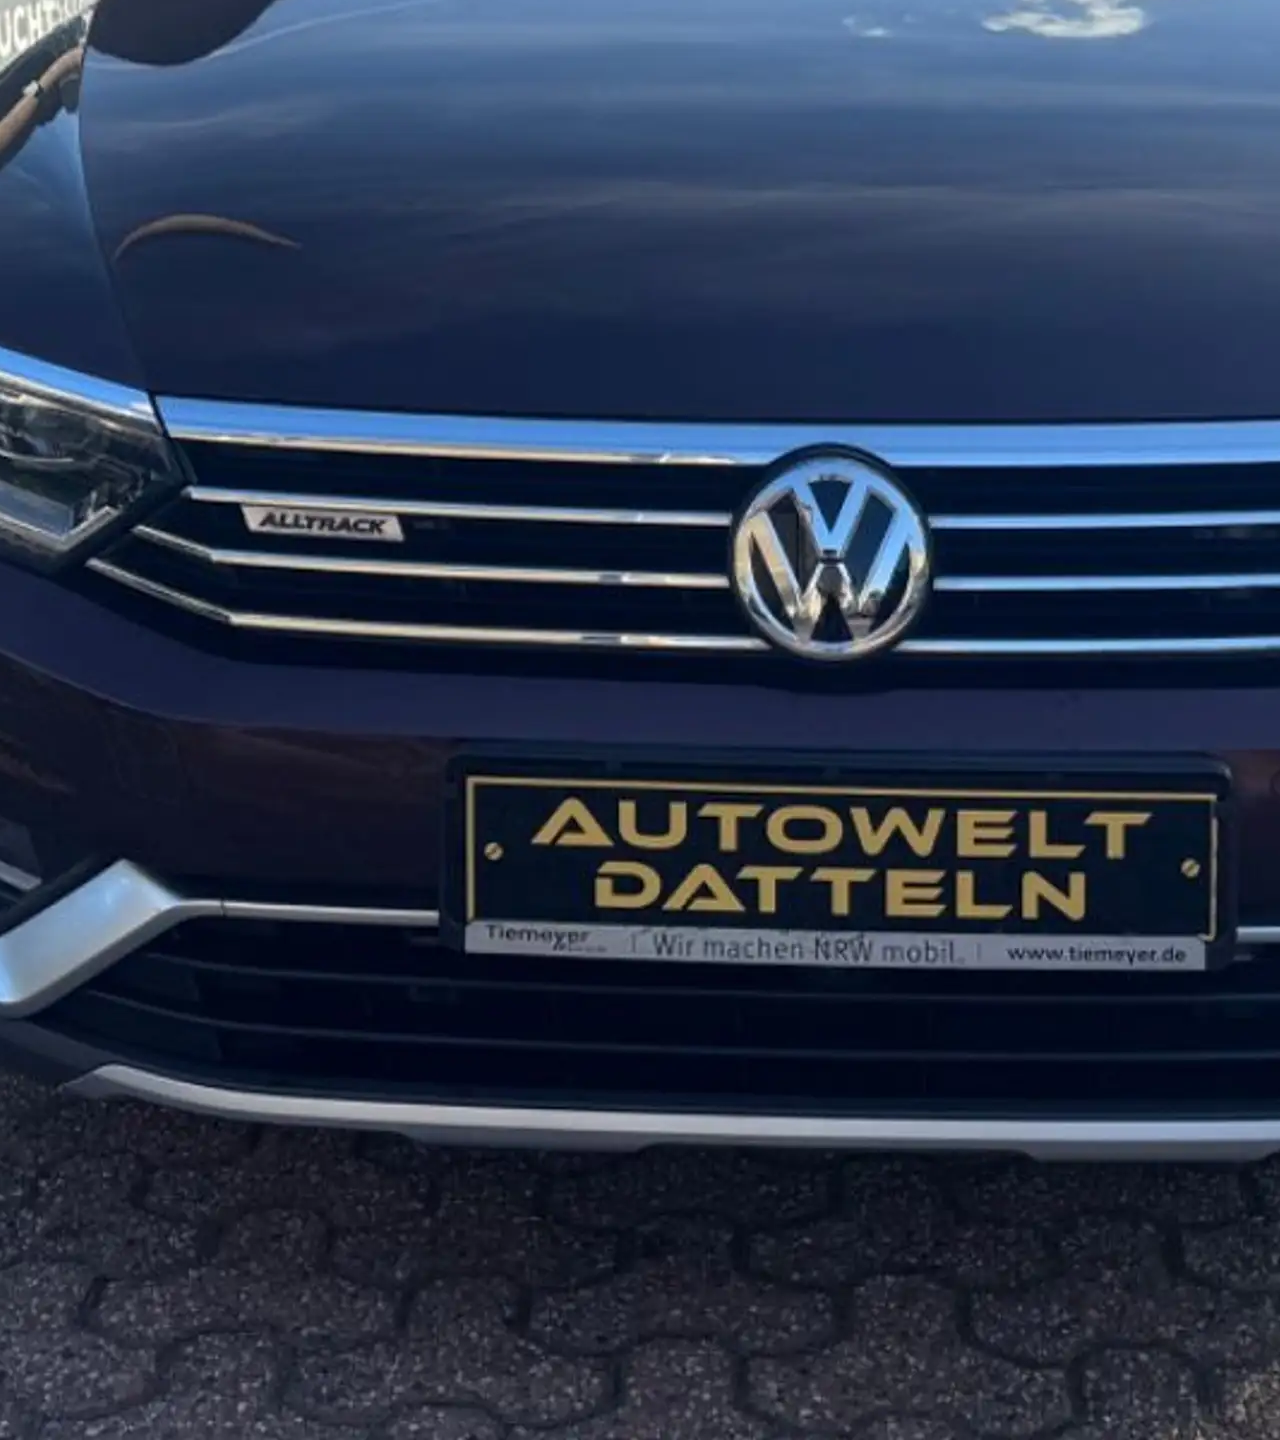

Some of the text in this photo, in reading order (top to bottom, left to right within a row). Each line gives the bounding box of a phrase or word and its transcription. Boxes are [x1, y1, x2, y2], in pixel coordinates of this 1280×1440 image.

[258, 511, 386, 535] ALLTRACK
[531, 796, 1152, 860] AUTOWELT
[594, 861, 1086, 921] DATTELN
[486, 923, 590, 951] Tiemeyer
[654, 934, 693, 957] Wir
[703, 934, 803, 960] machen
[815, 936, 872, 962] NRW
[1006, 945, 1187, 966] www.tiemeyer.de
